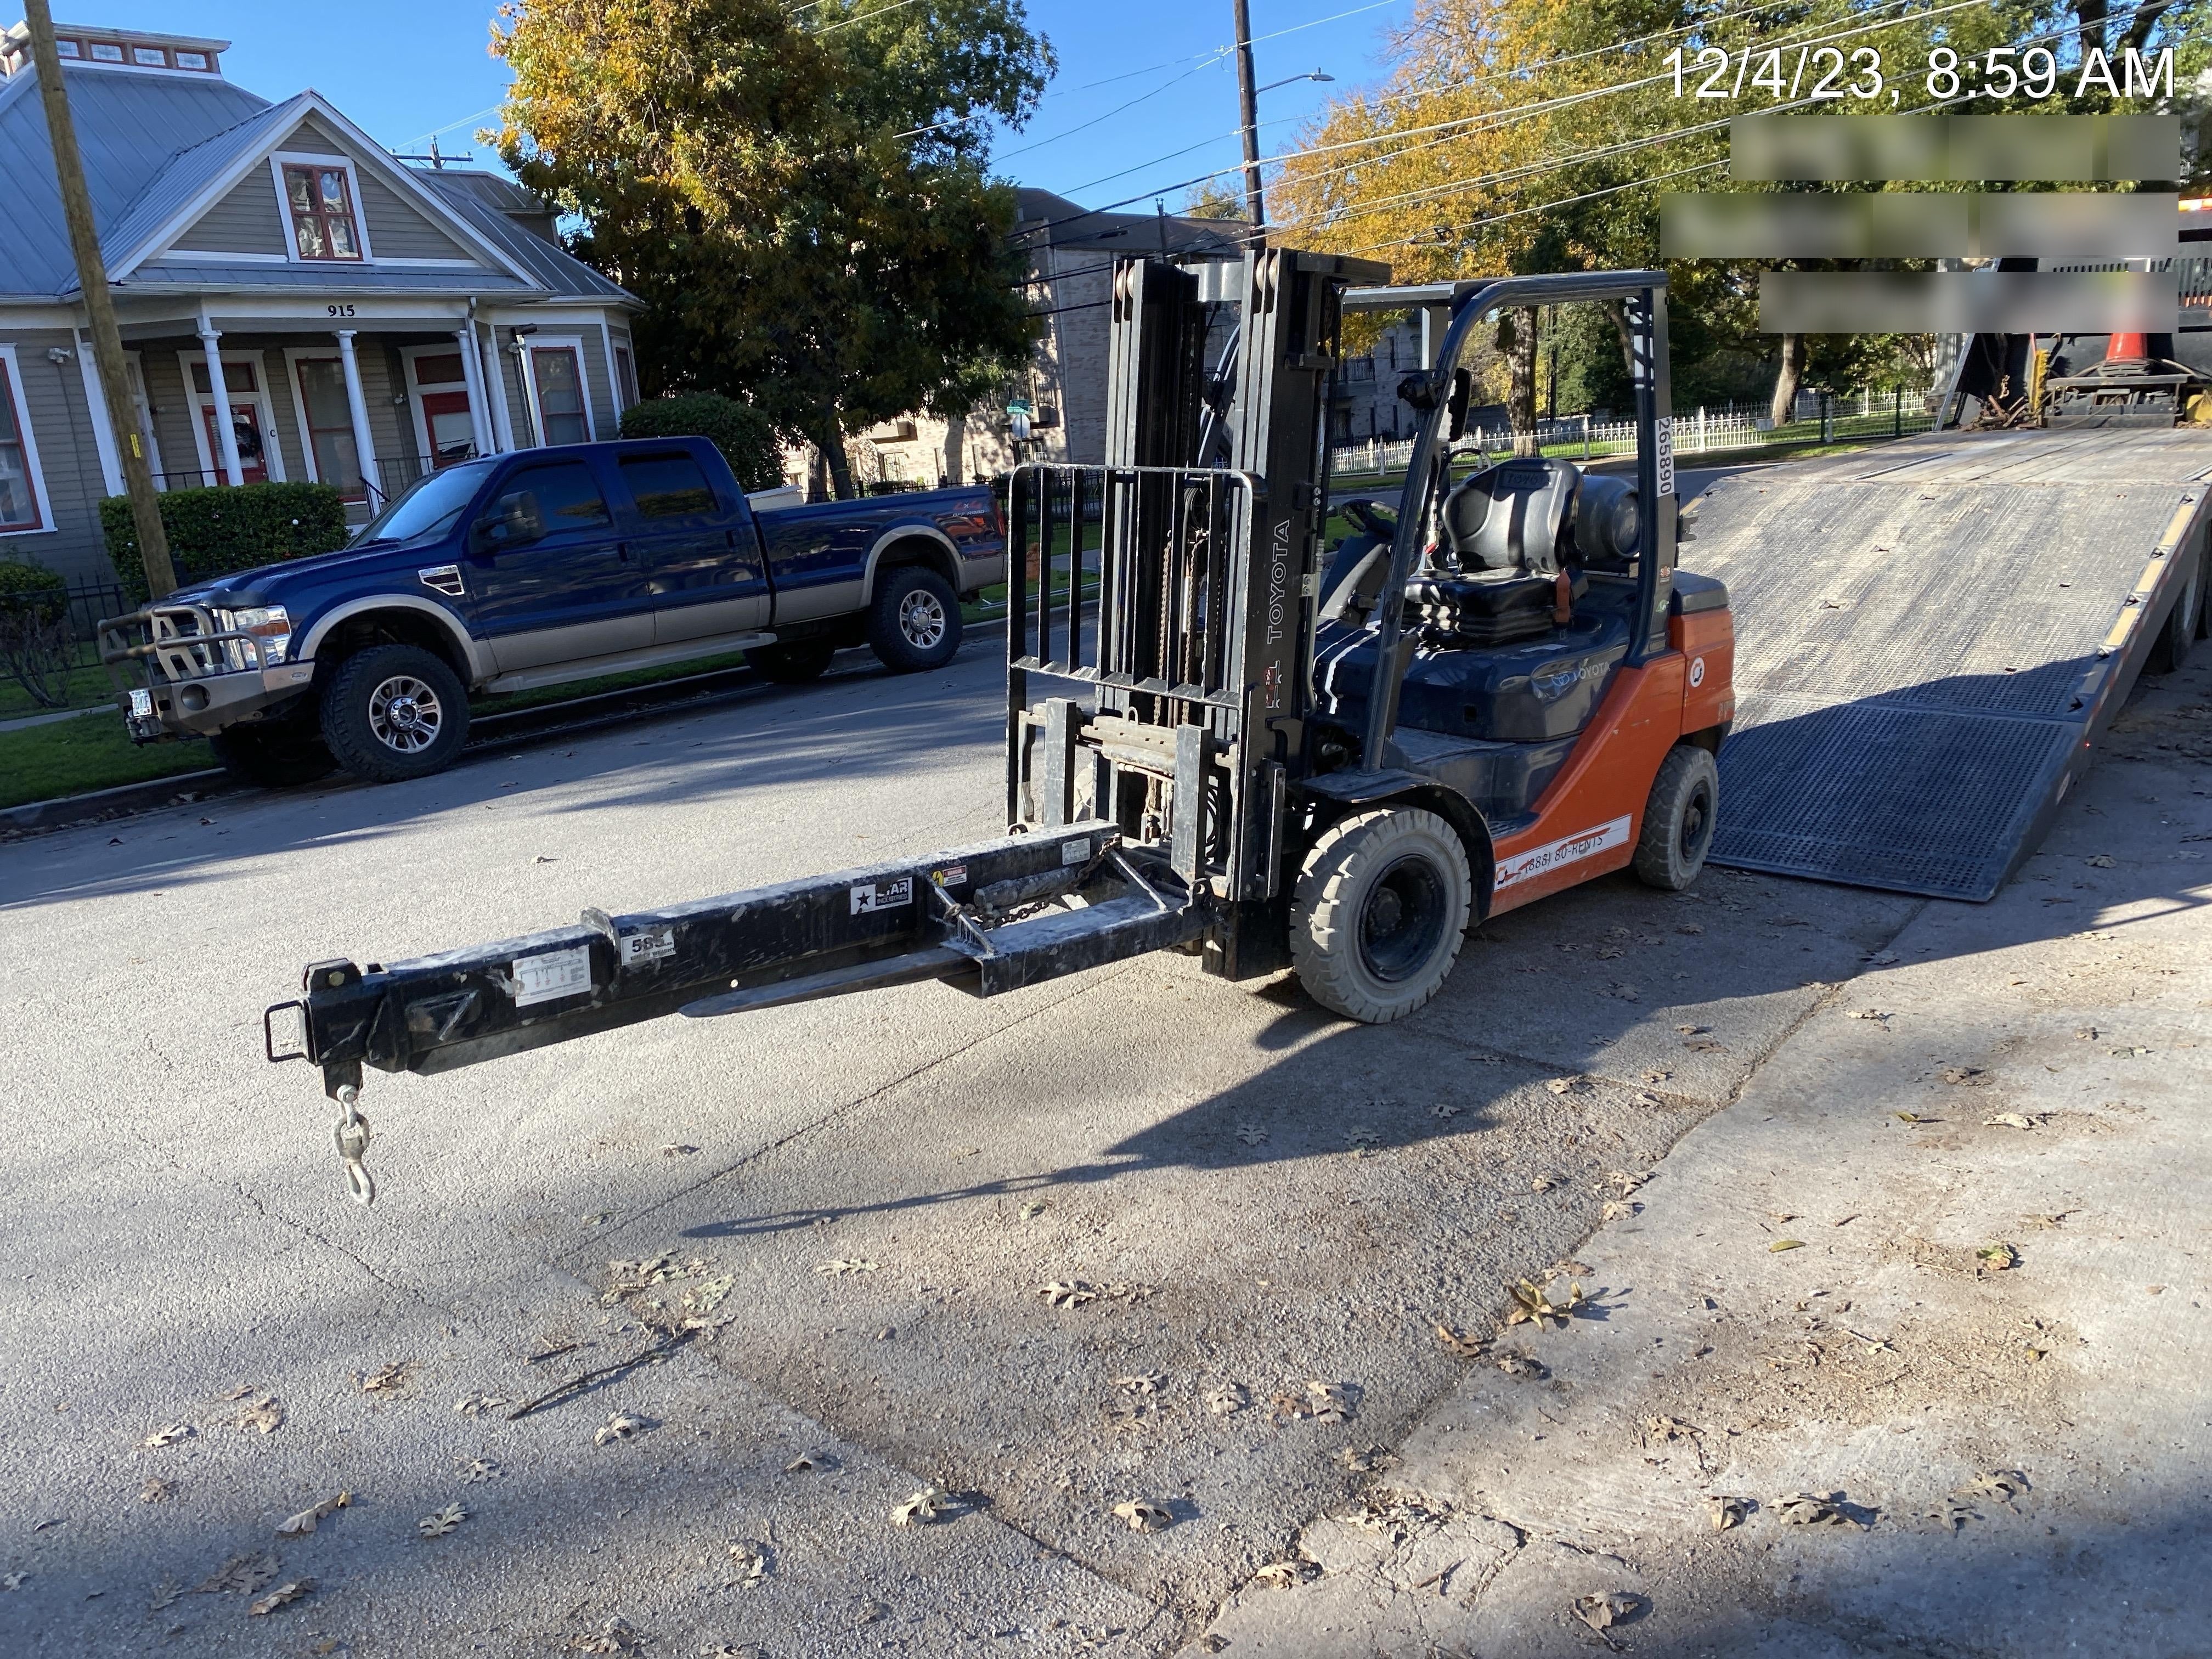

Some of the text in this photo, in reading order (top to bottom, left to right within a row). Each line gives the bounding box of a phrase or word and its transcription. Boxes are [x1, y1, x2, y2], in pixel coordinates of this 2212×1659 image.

[328, 304, 355, 317] 915
[270, 429, 276, 437] C
[1658, 417, 1672, 494] 265890
[1267, 519, 1290, 645] TOYOTA
[1525, 851, 1551, 874] (888)
[876, 881, 908, 897] AR
